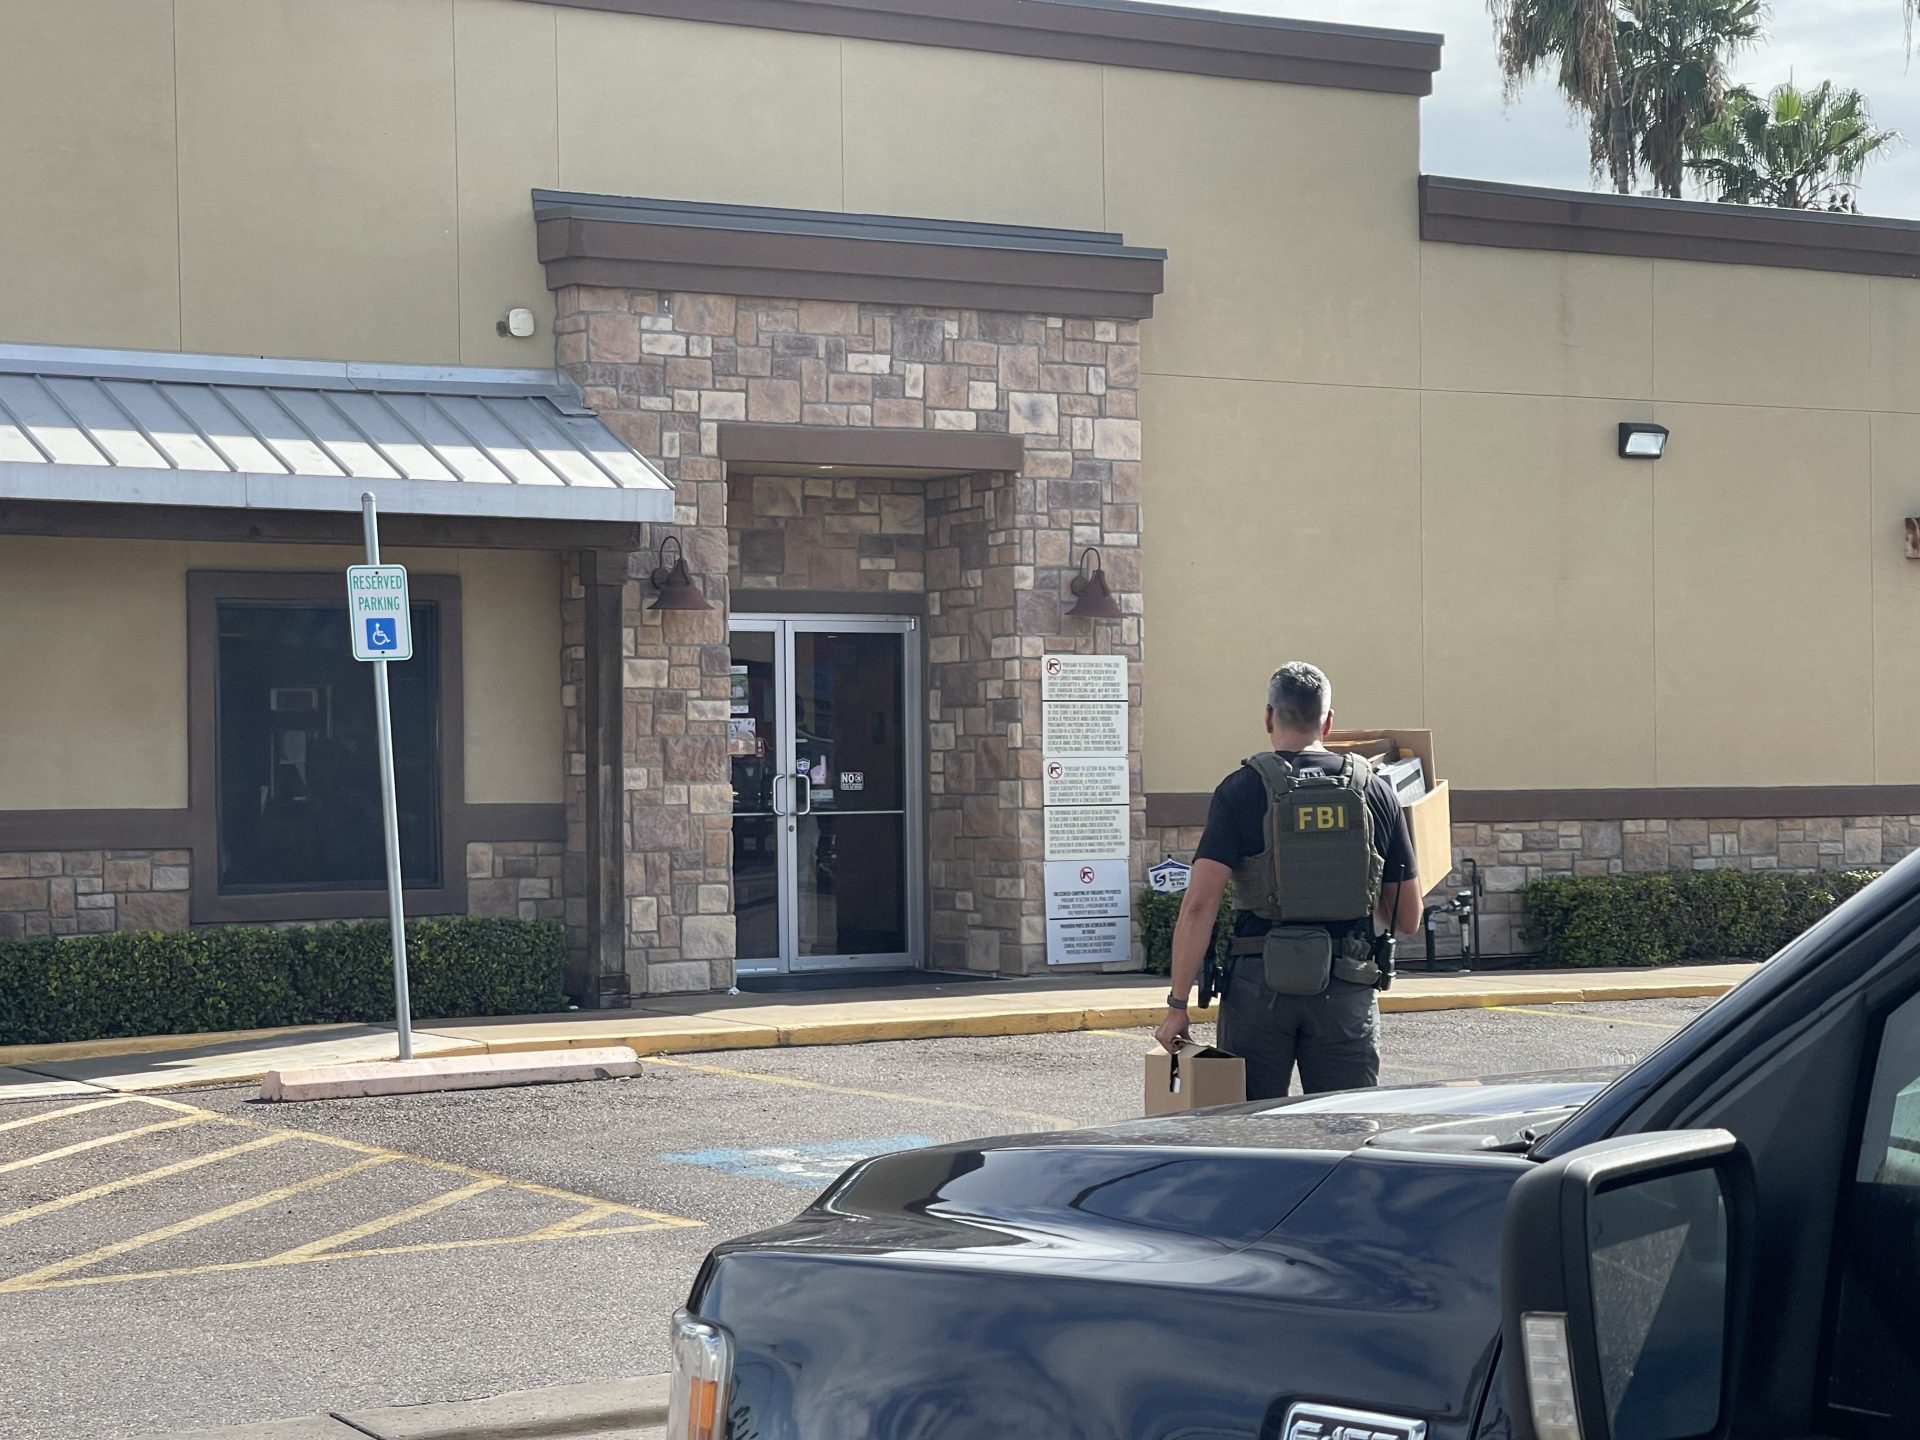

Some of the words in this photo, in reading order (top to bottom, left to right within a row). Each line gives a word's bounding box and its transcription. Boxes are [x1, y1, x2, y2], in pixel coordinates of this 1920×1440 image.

[353, 575, 402, 590] RESERVED
[359, 596, 400, 610] PARKING
[842, 773, 855, 783] NO
[1298, 806, 1345, 830] FBI
